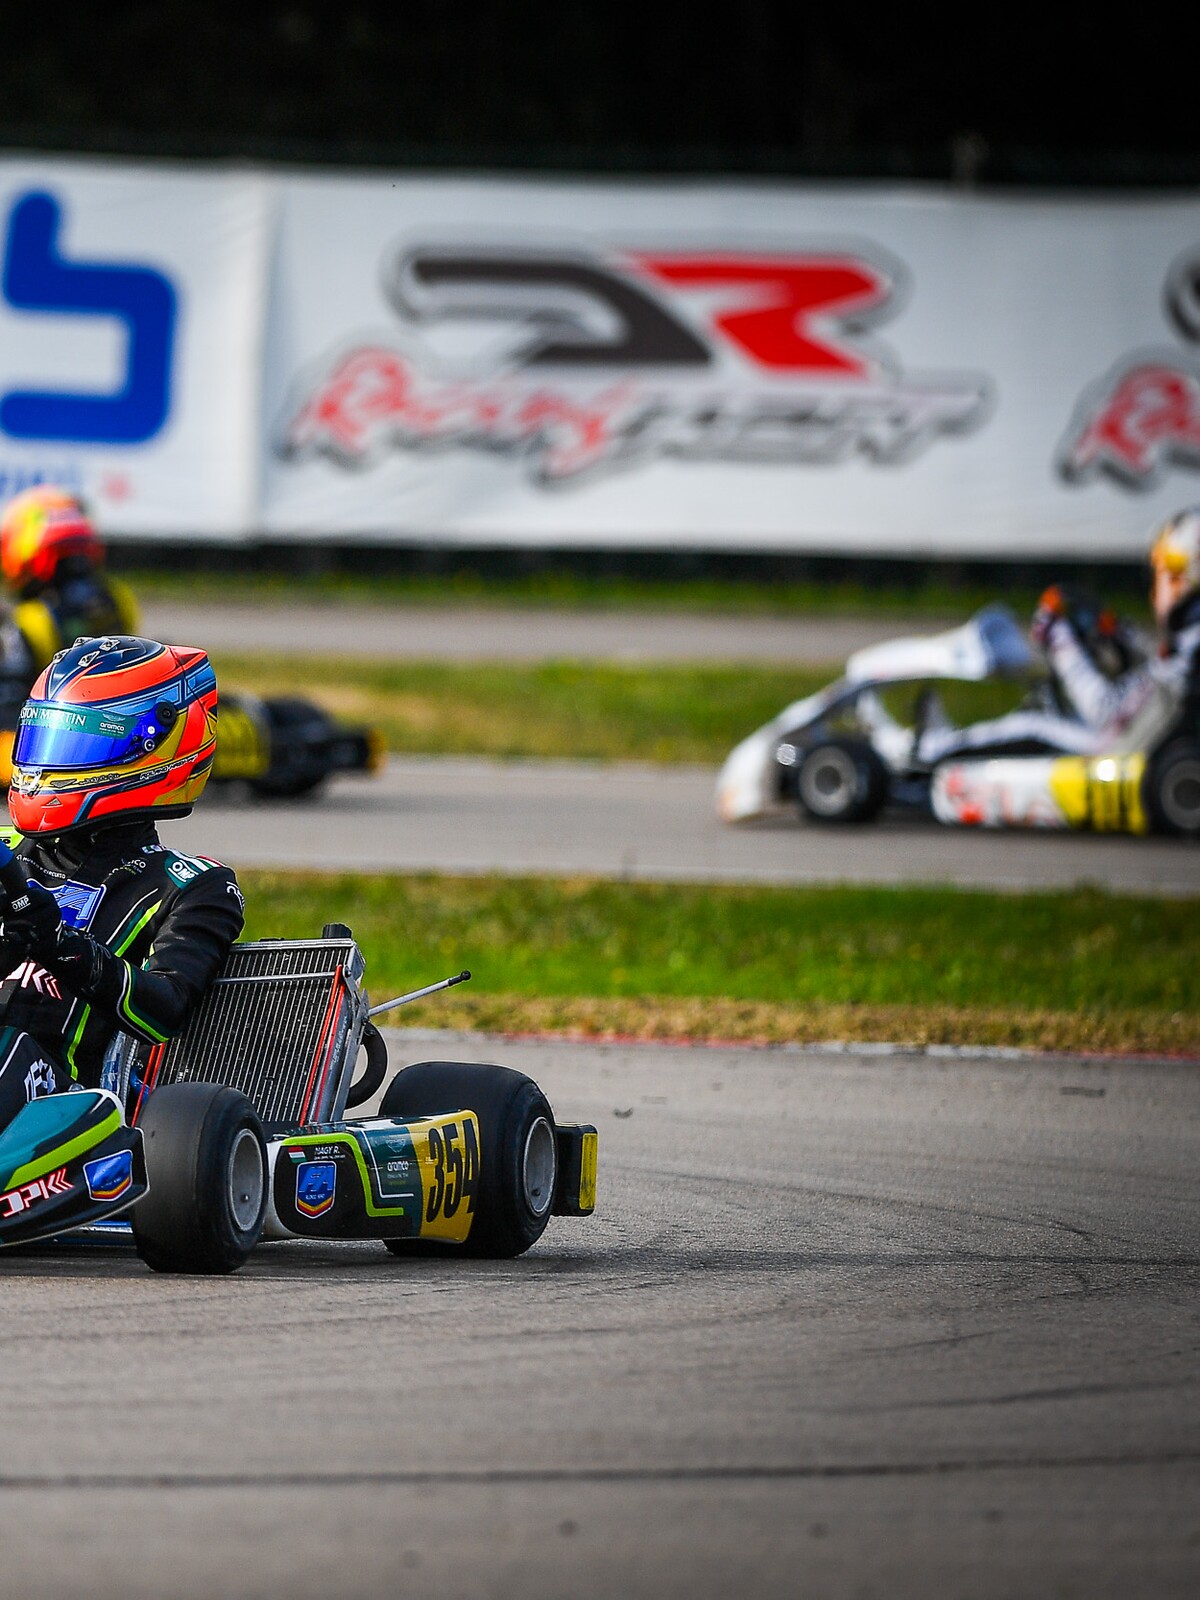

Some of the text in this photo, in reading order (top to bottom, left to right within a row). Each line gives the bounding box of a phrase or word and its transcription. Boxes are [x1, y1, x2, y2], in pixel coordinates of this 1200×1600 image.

[99, 722, 125, 732] aramco
[172, 861, 196, 880] OMP
[12, 897, 30, 911] OMP
[426, 1119, 479, 1223] 354
